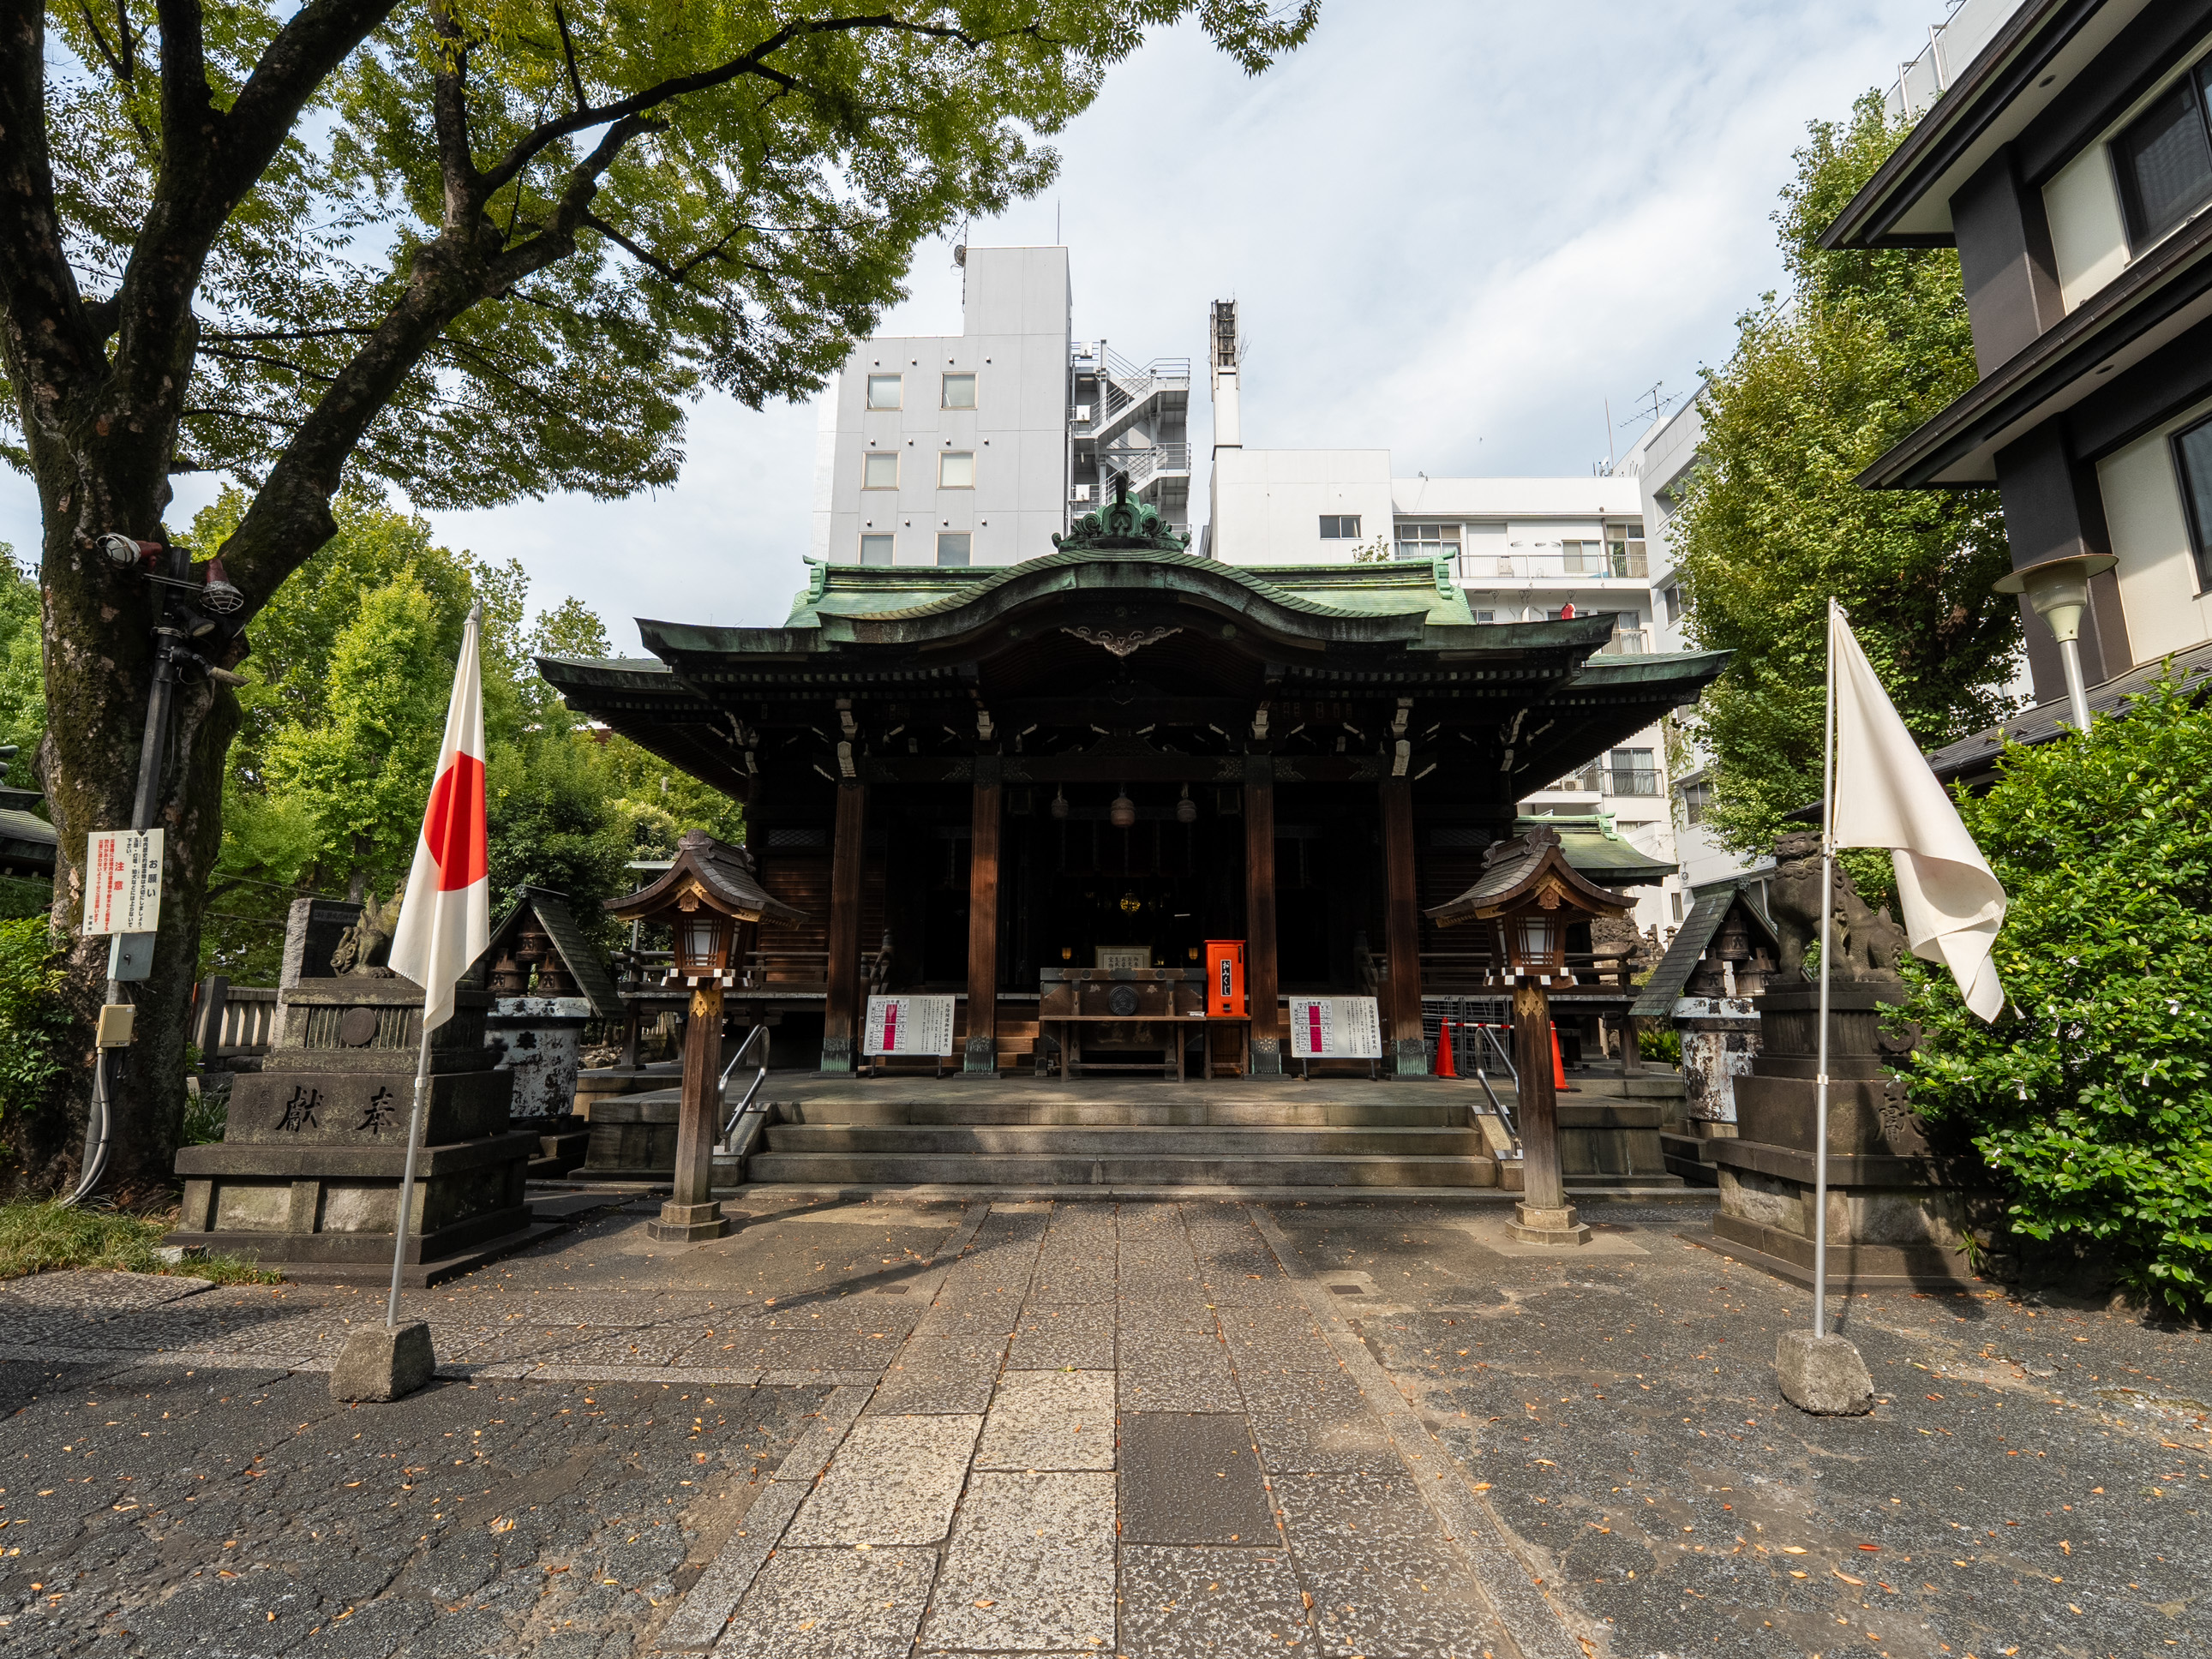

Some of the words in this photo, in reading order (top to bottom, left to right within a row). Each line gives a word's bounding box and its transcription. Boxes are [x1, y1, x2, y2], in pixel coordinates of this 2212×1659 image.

[114, 861, 124, 890] 注意
[147, 859, 158, 897] お願い
